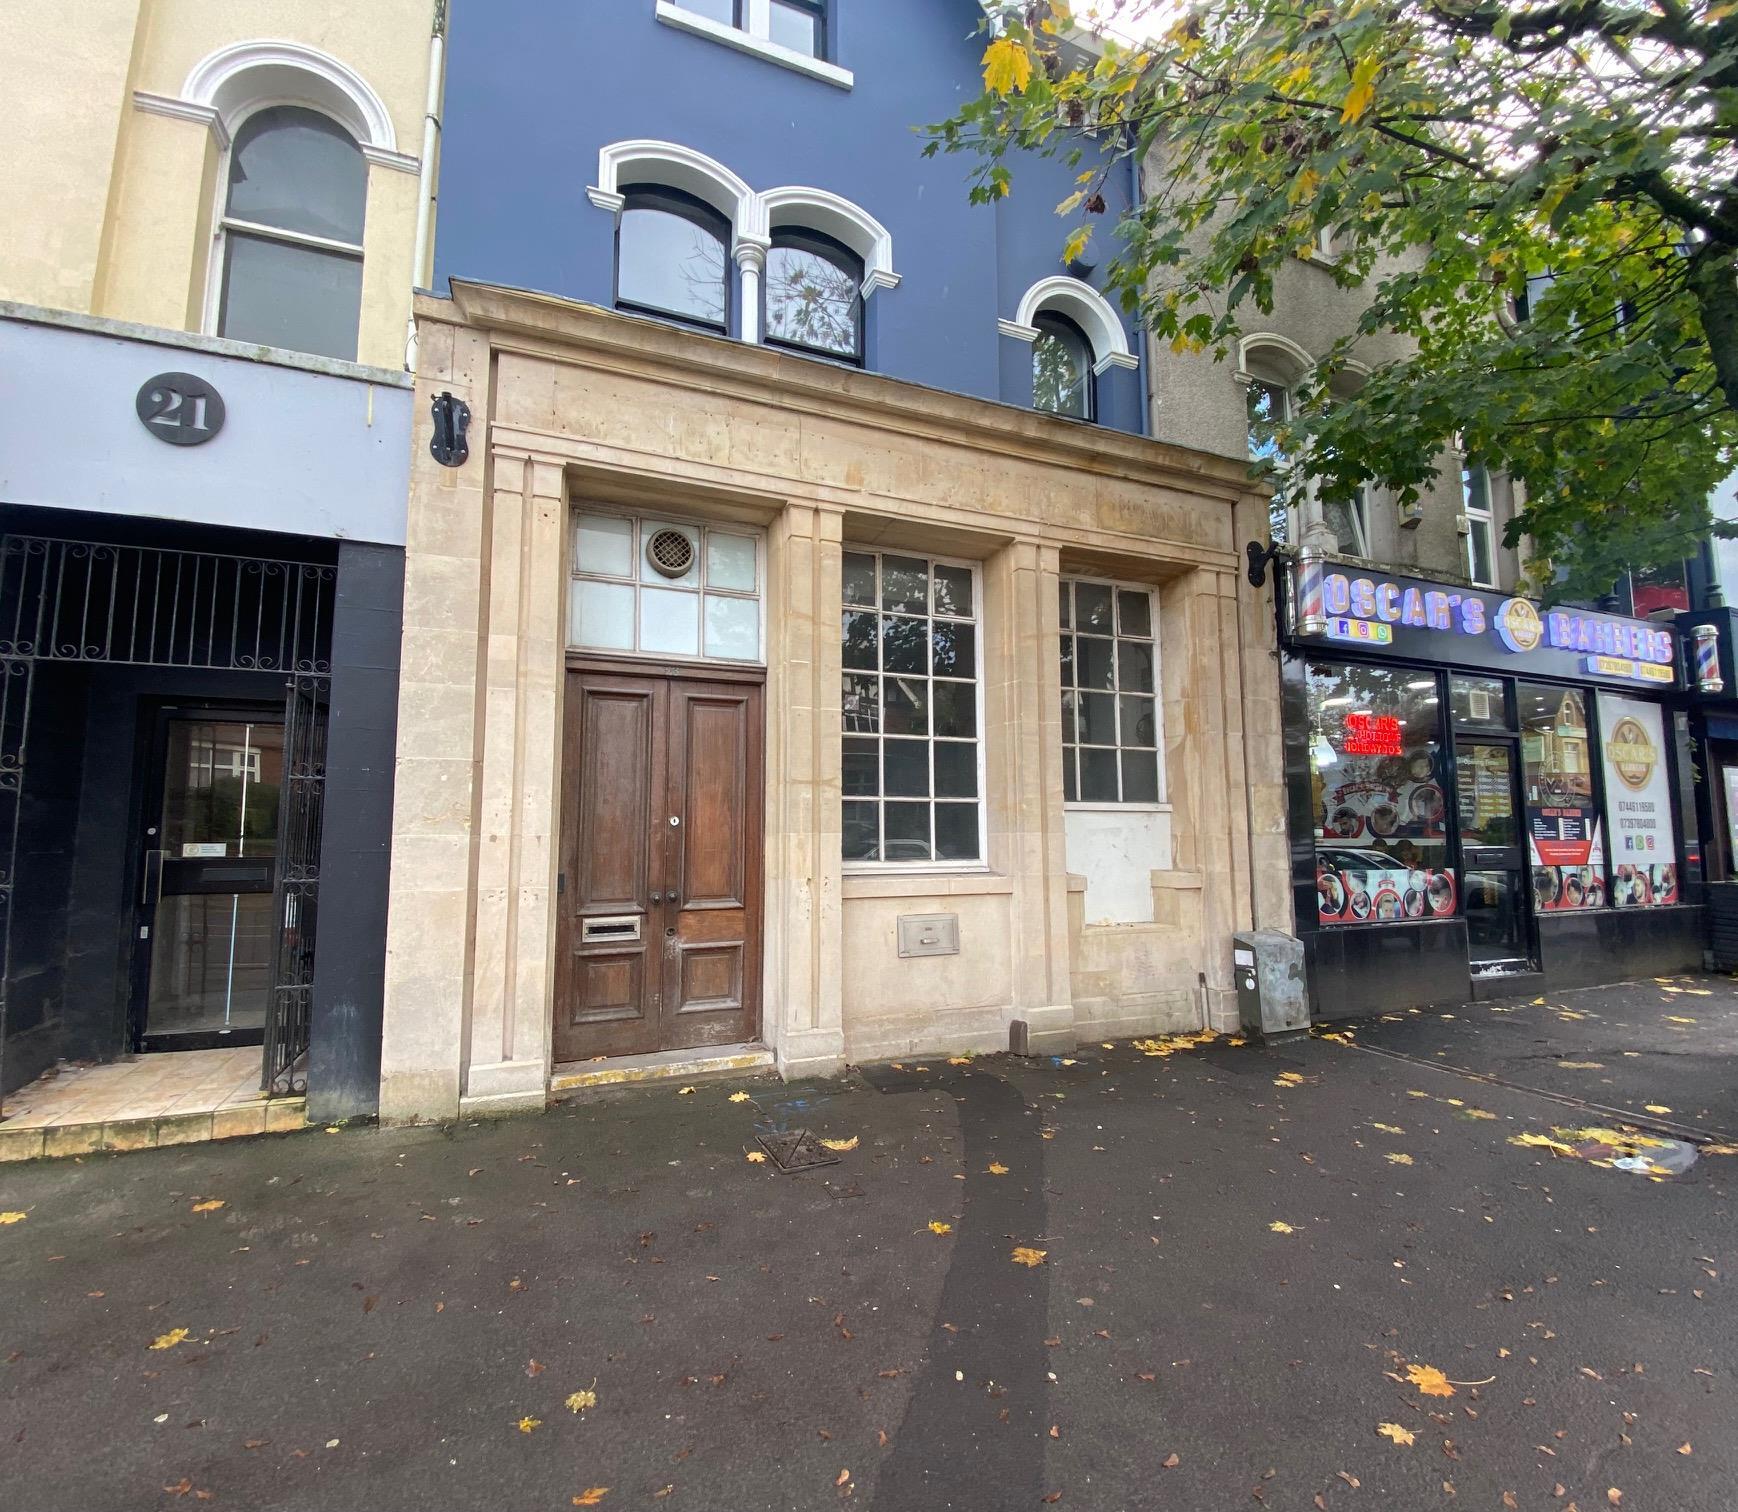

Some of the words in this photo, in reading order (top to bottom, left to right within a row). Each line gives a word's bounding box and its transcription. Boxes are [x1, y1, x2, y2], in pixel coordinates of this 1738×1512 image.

[148, 388, 209, 431] 21
[1323, 573, 1486, 634] OSCAR'S
[1549, 613, 1673, 663] BARBERS
[1608, 745, 1656, 761] OSCAR'S
